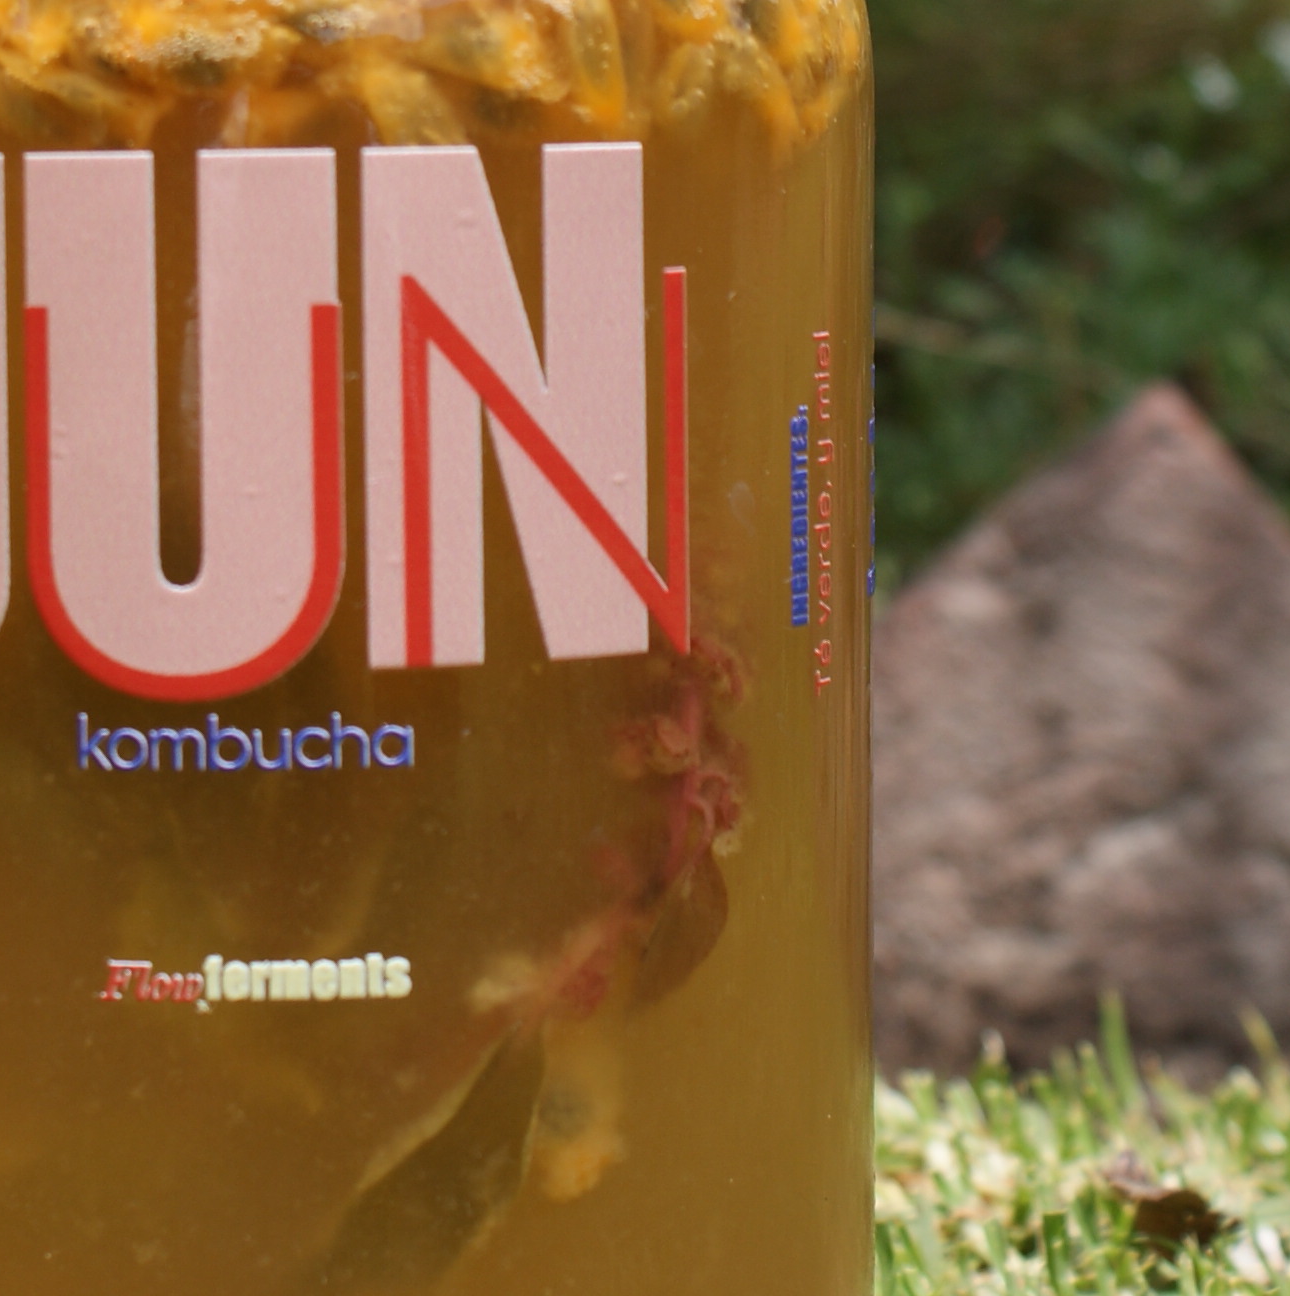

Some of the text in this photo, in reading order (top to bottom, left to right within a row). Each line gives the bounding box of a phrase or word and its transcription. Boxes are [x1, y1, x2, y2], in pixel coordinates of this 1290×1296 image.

[790, 405, 808, 627] INGREDIENTES:
[812, 330, 834, 697] Té verde, y miel
[77, 710, 415, 771] kombucha
